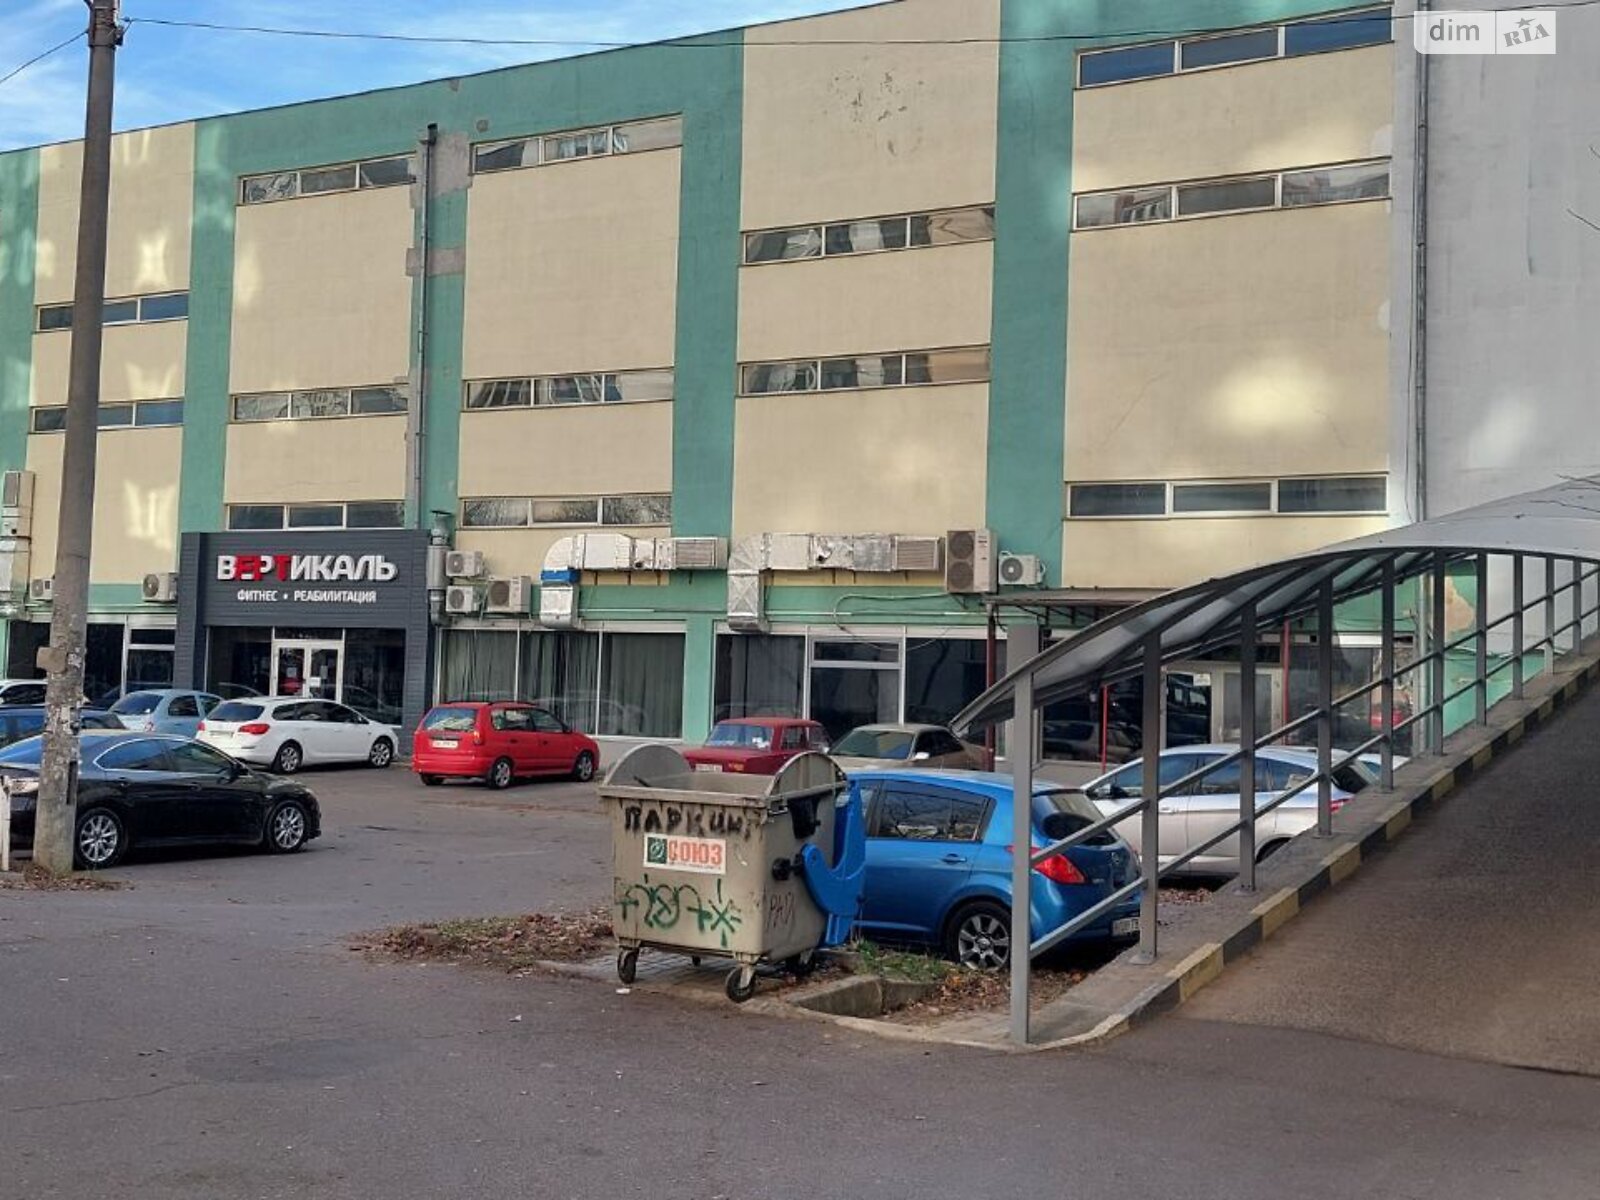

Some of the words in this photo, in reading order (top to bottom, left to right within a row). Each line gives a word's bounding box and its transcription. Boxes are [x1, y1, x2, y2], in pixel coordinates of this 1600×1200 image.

[216, 555, 398, 581] ВЕРТИКАЛЬ
[237, 590, 278, 602] ФИТНЕС
[294, 590, 377, 604] РЕАБИЛИТАЦИЯ
[668, 840, 721, 865] СОЮЗ
